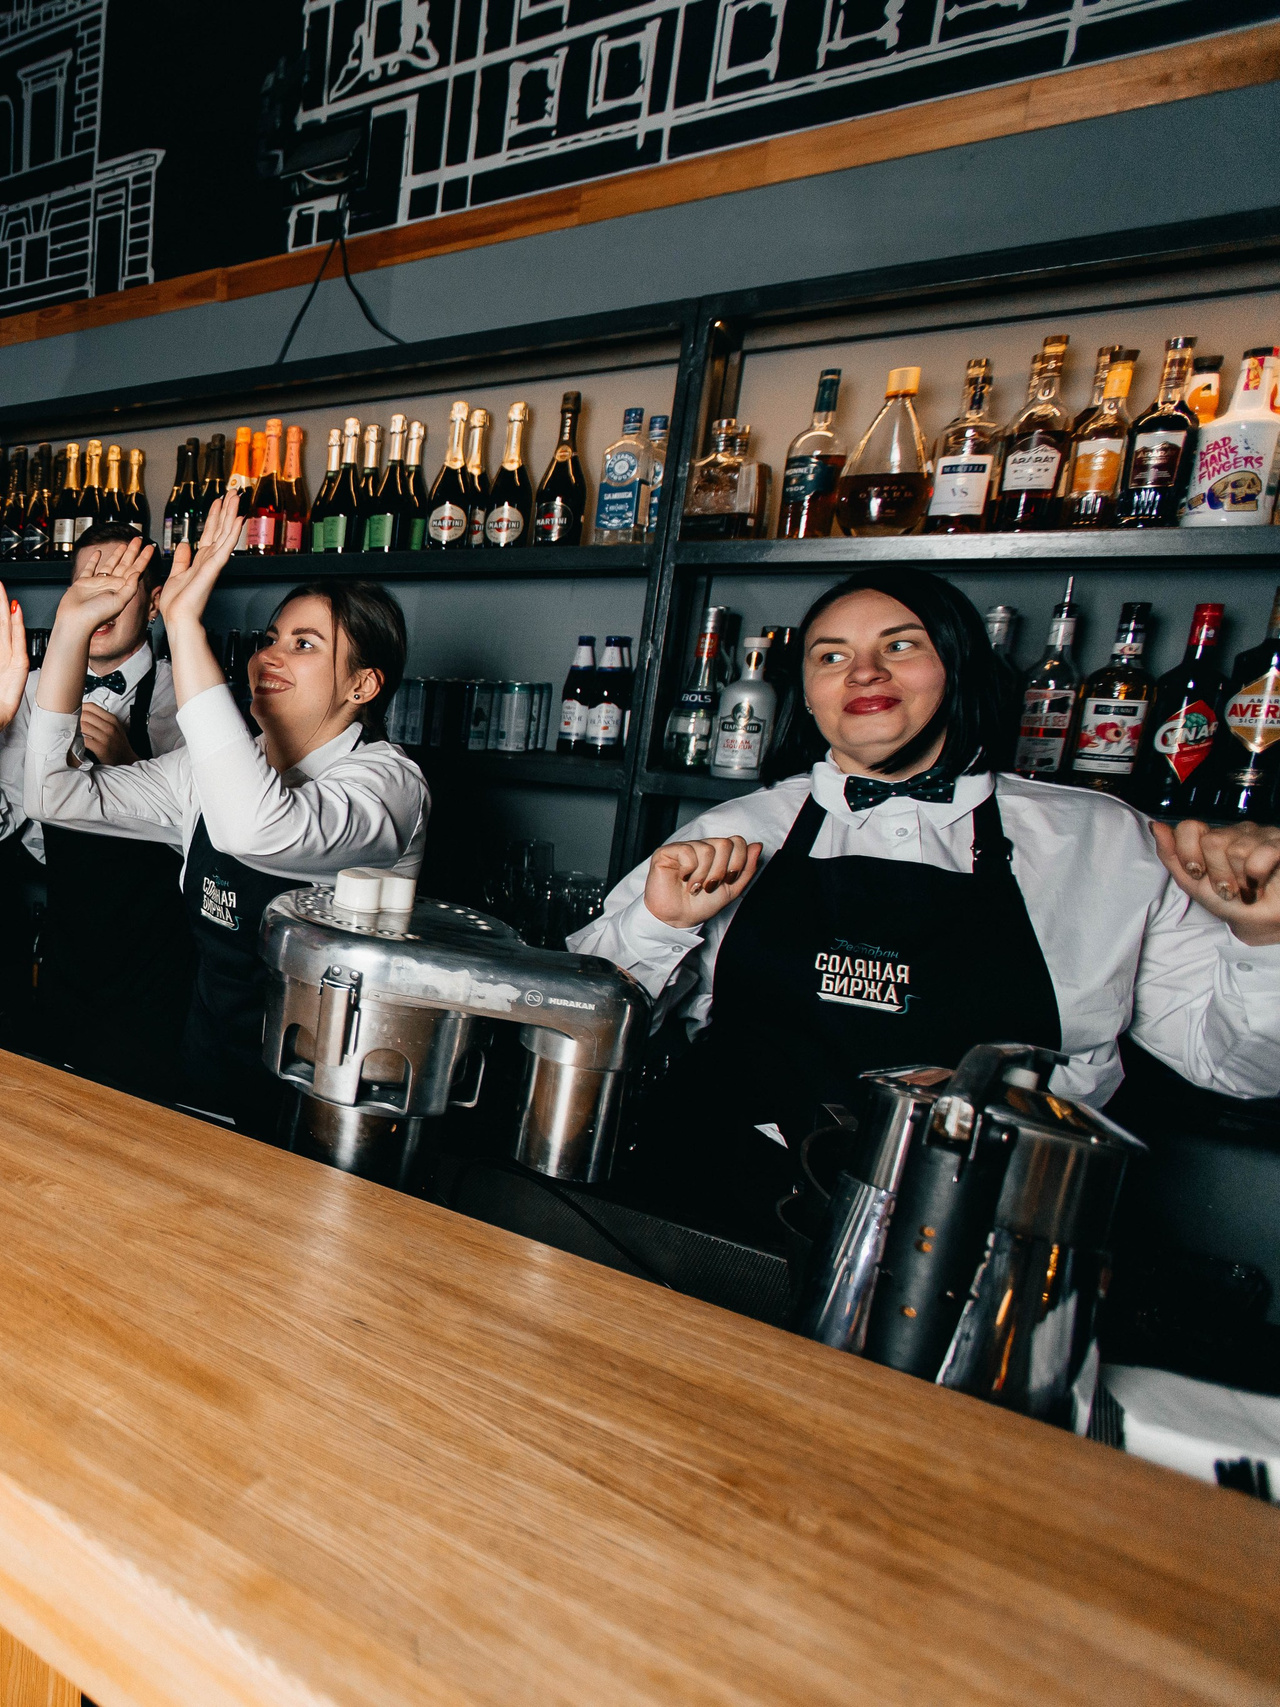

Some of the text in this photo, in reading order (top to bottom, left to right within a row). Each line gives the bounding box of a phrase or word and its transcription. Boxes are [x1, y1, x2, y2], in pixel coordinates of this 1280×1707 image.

[563, 412, 572, 441] BRUT
[1199, 436, 1232, 462] DEAD
[1199, 445, 1239, 472] MAN'S
[1010, 456, 1056, 465] ARARAT
[1198, 455, 1264, 485] FINGERS
[431, 519, 463, 527] MARTINI
[488, 521, 520, 529] MARTINI
[536, 517, 567, 526] MARTINI
[681, 693, 712, 703] BOLS
[1227, 703, 1280, 719] AVER
[1154, 719, 1219, 754] CYNAR
[830, 937, 899, 959] Ресторан
[815, 952, 910, 984] СОЛЯНАЯ
[820, 973, 900, 1004] БИРЖА
[548, 996, 596, 1011] HURAKAN
